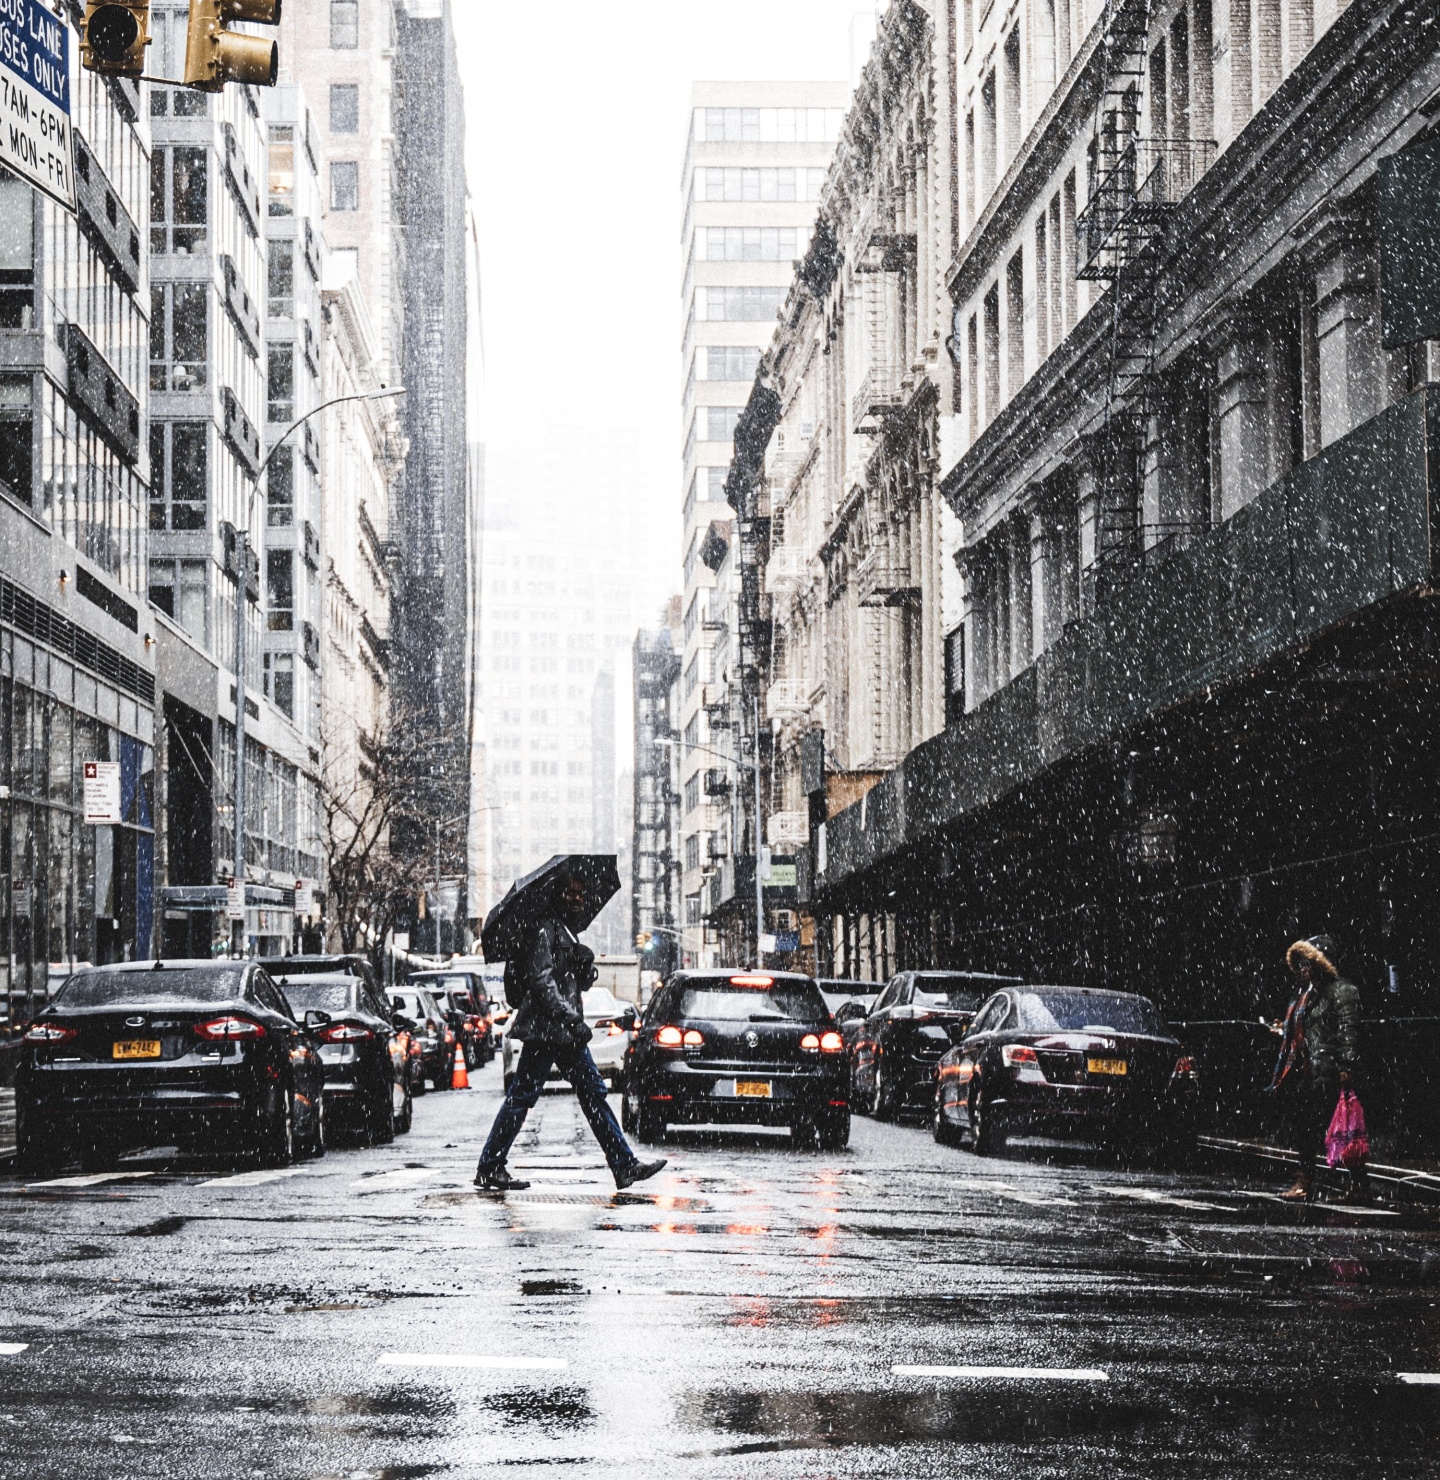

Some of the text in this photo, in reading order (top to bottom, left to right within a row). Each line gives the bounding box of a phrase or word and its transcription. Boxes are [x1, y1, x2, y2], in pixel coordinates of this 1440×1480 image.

[28, 7, 63, 61] LANE
[33, 52, 65, 101] ONLY
[9, 123, 69, 193] MON-FRI
